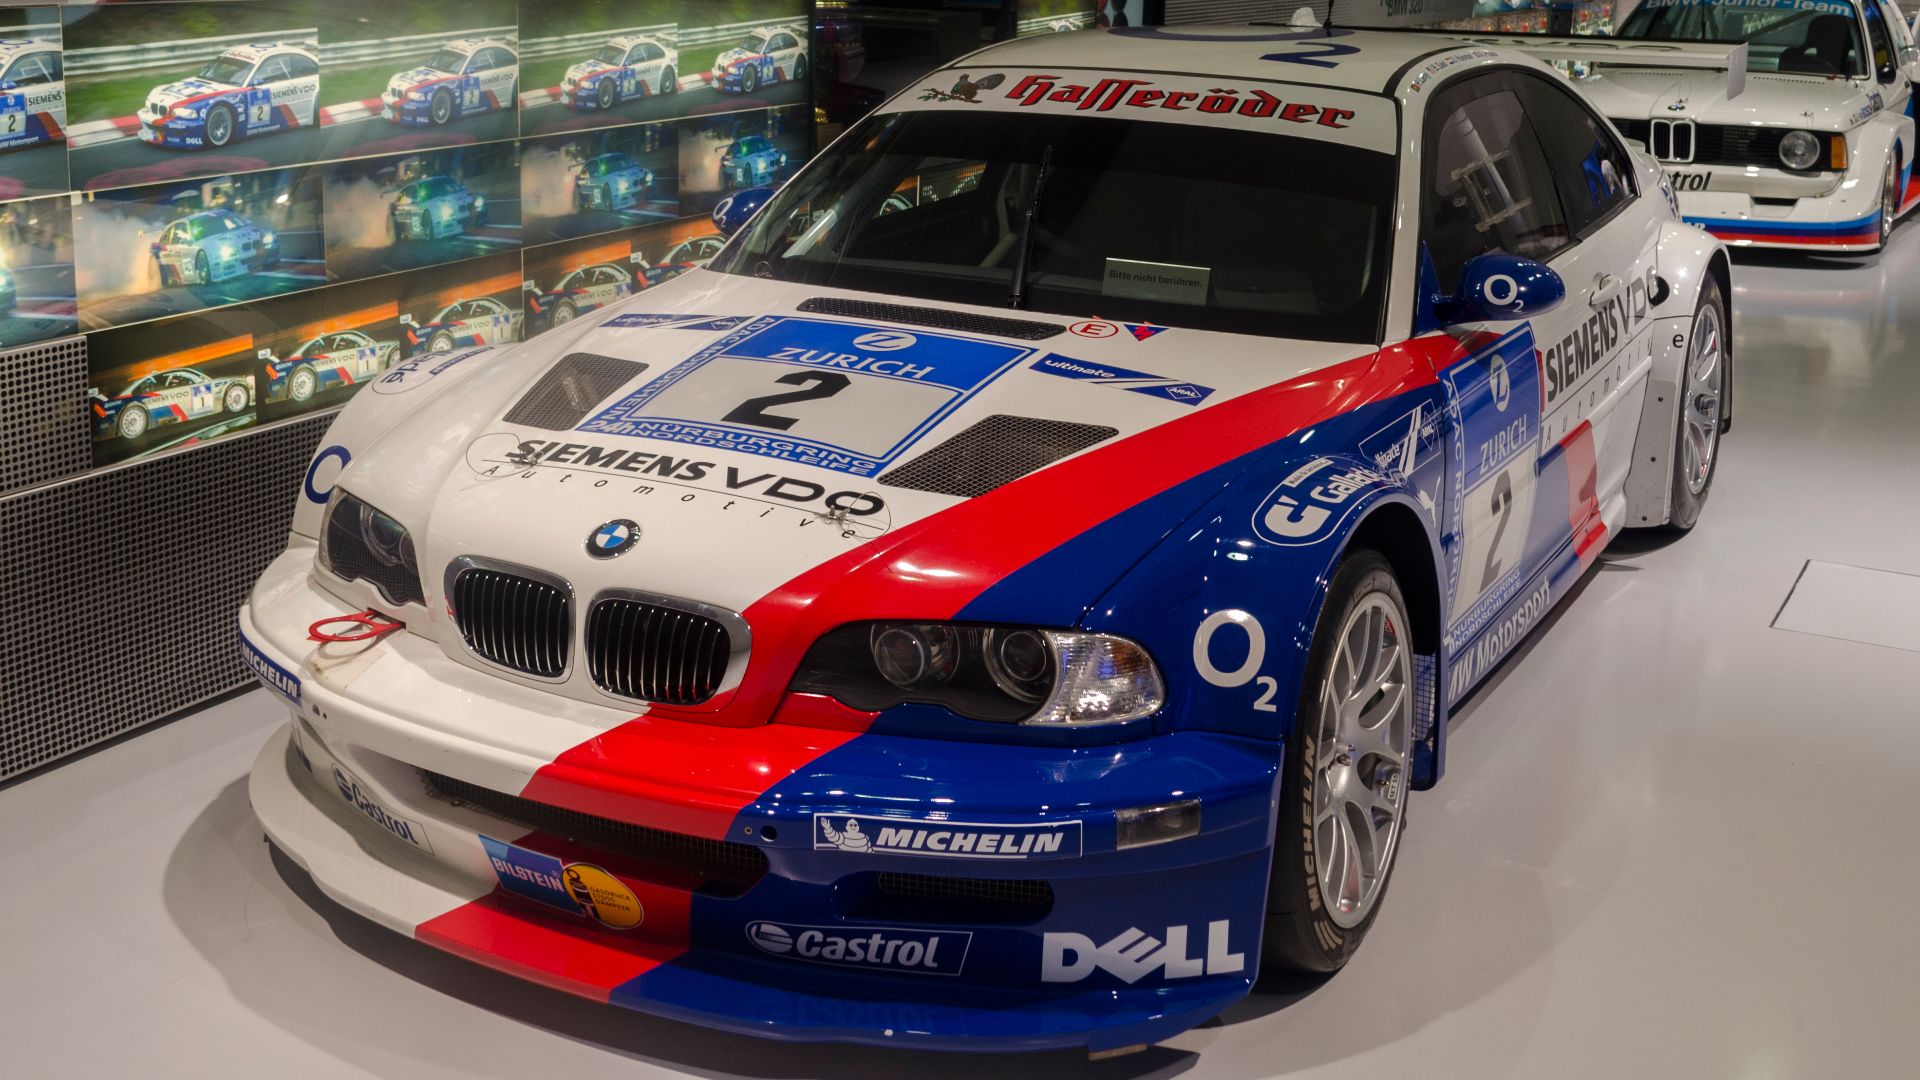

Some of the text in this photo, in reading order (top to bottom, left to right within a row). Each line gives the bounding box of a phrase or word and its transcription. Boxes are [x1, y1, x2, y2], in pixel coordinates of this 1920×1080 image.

[28, 91, 62, 106] SIEMENS
[258, 106, 264, 121] 2
[8, 114, 16, 133] 2
[1672, 171, 1712, 191] trol
[1109, 270, 1131, 280] Bitte
[1133, 273, 1156, 283] nicht
[767, 347, 936, 379] ZURICH
[1045, 359, 1116, 379] ultimate
[1547, 302, 1617, 402] SIEMENS
[720, 370, 852, 431] 2
[1169, 387, 1197, 398] ARAL
[1480, 414, 1528, 475] ZURICH
[504, 438, 884, 517] SIEMENS VDO
[1480, 469, 1513, 593] 2
[1475, 576, 1551, 678] Motorsport
[351, 783, 419, 845] Castrol
[1303, 734, 1321, 911] MICHELIN
[876, 826, 1064, 854] MICHELIN
[491, 856, 566, 893] BILSTEIN
[796, 930, 940, 969] Castrol
[1041, 919, 1245, 984] DELL
